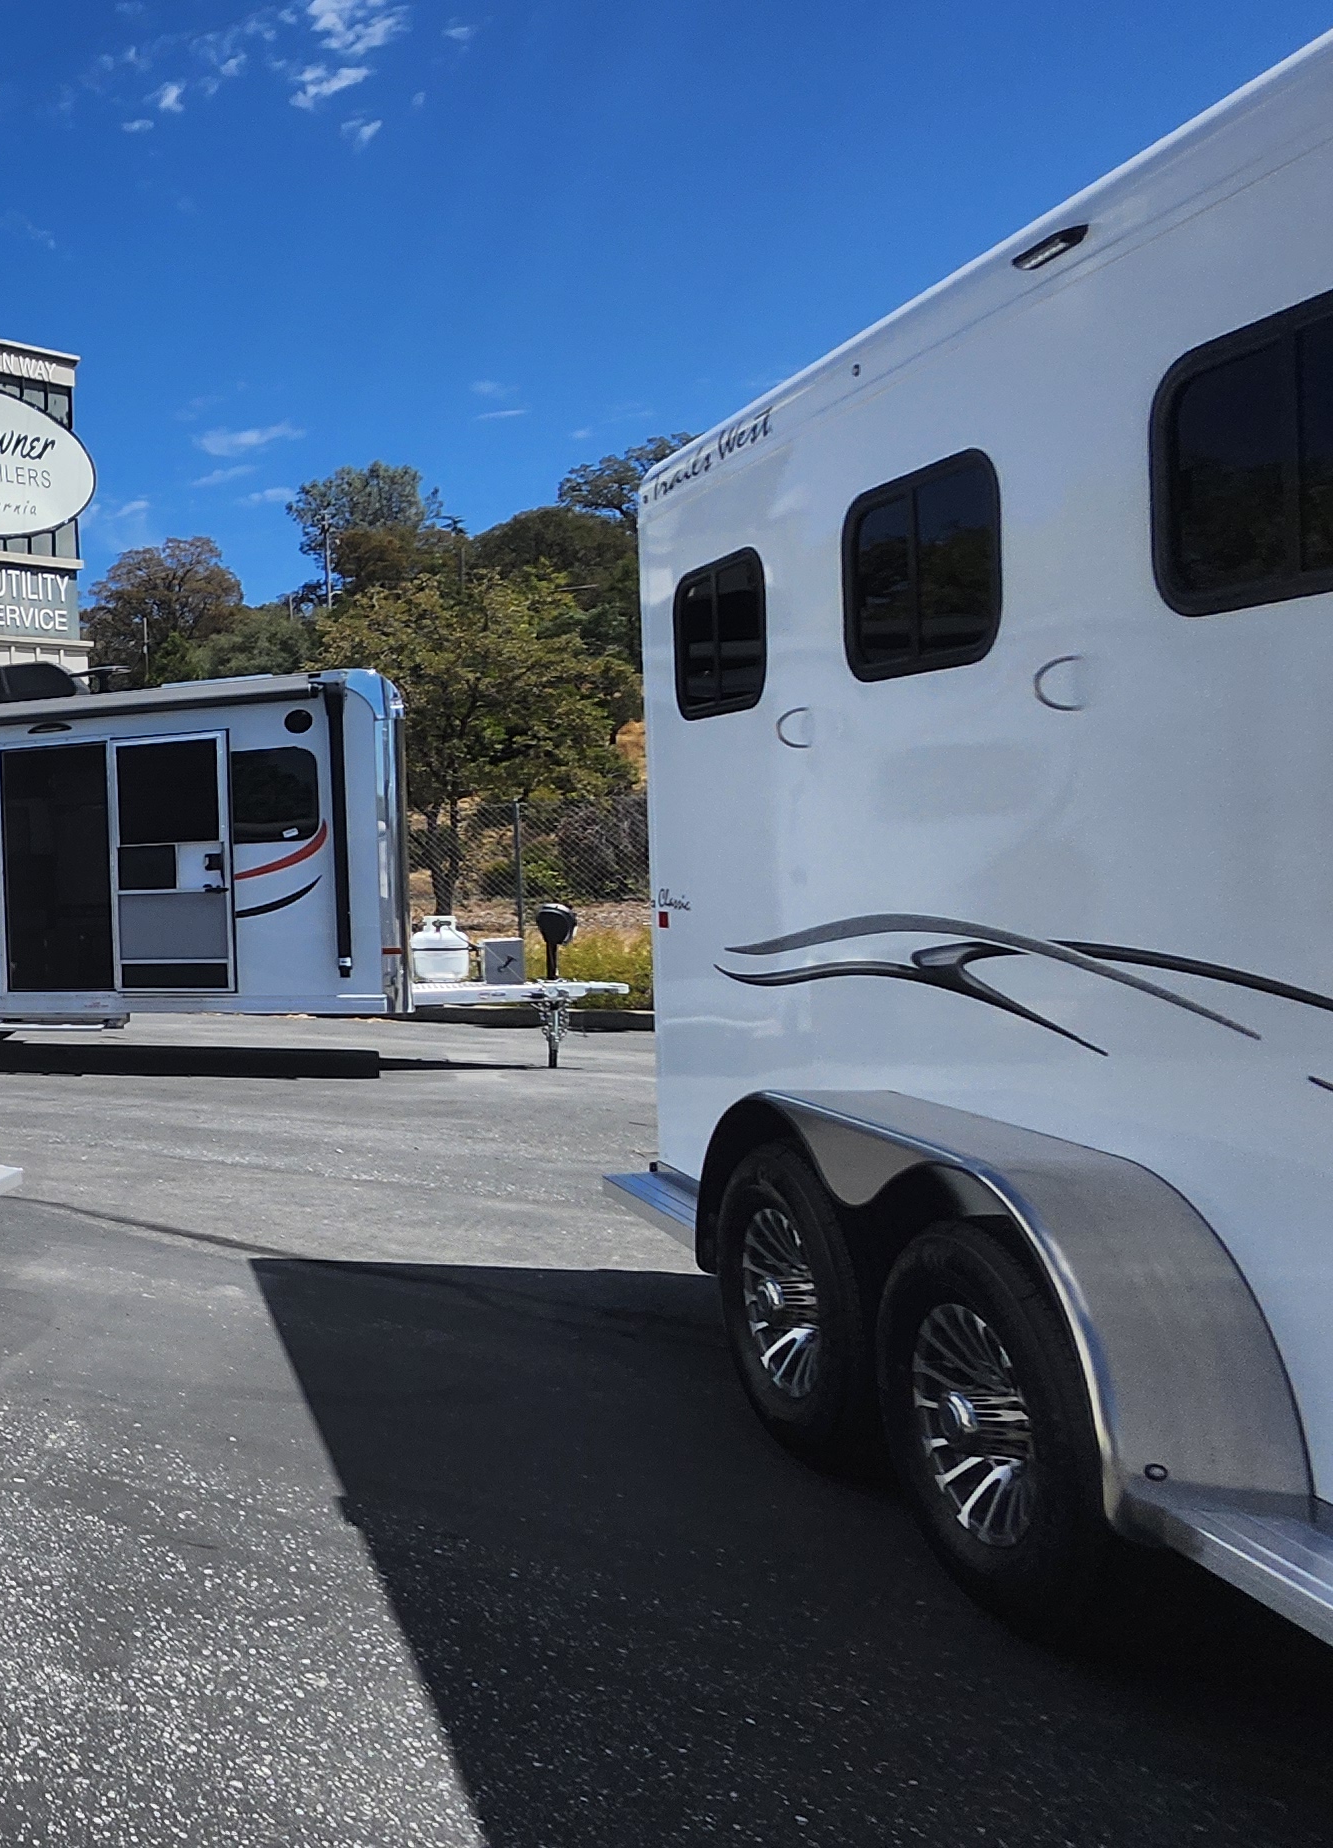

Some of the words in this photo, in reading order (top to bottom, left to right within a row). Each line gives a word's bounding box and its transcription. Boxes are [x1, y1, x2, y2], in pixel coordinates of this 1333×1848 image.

[18, 355, 57, 382] WAY
[649, 446, 714, 501] Trails
[717, 405, 773, 461] West
[658, 888, 692, 911] Classic
